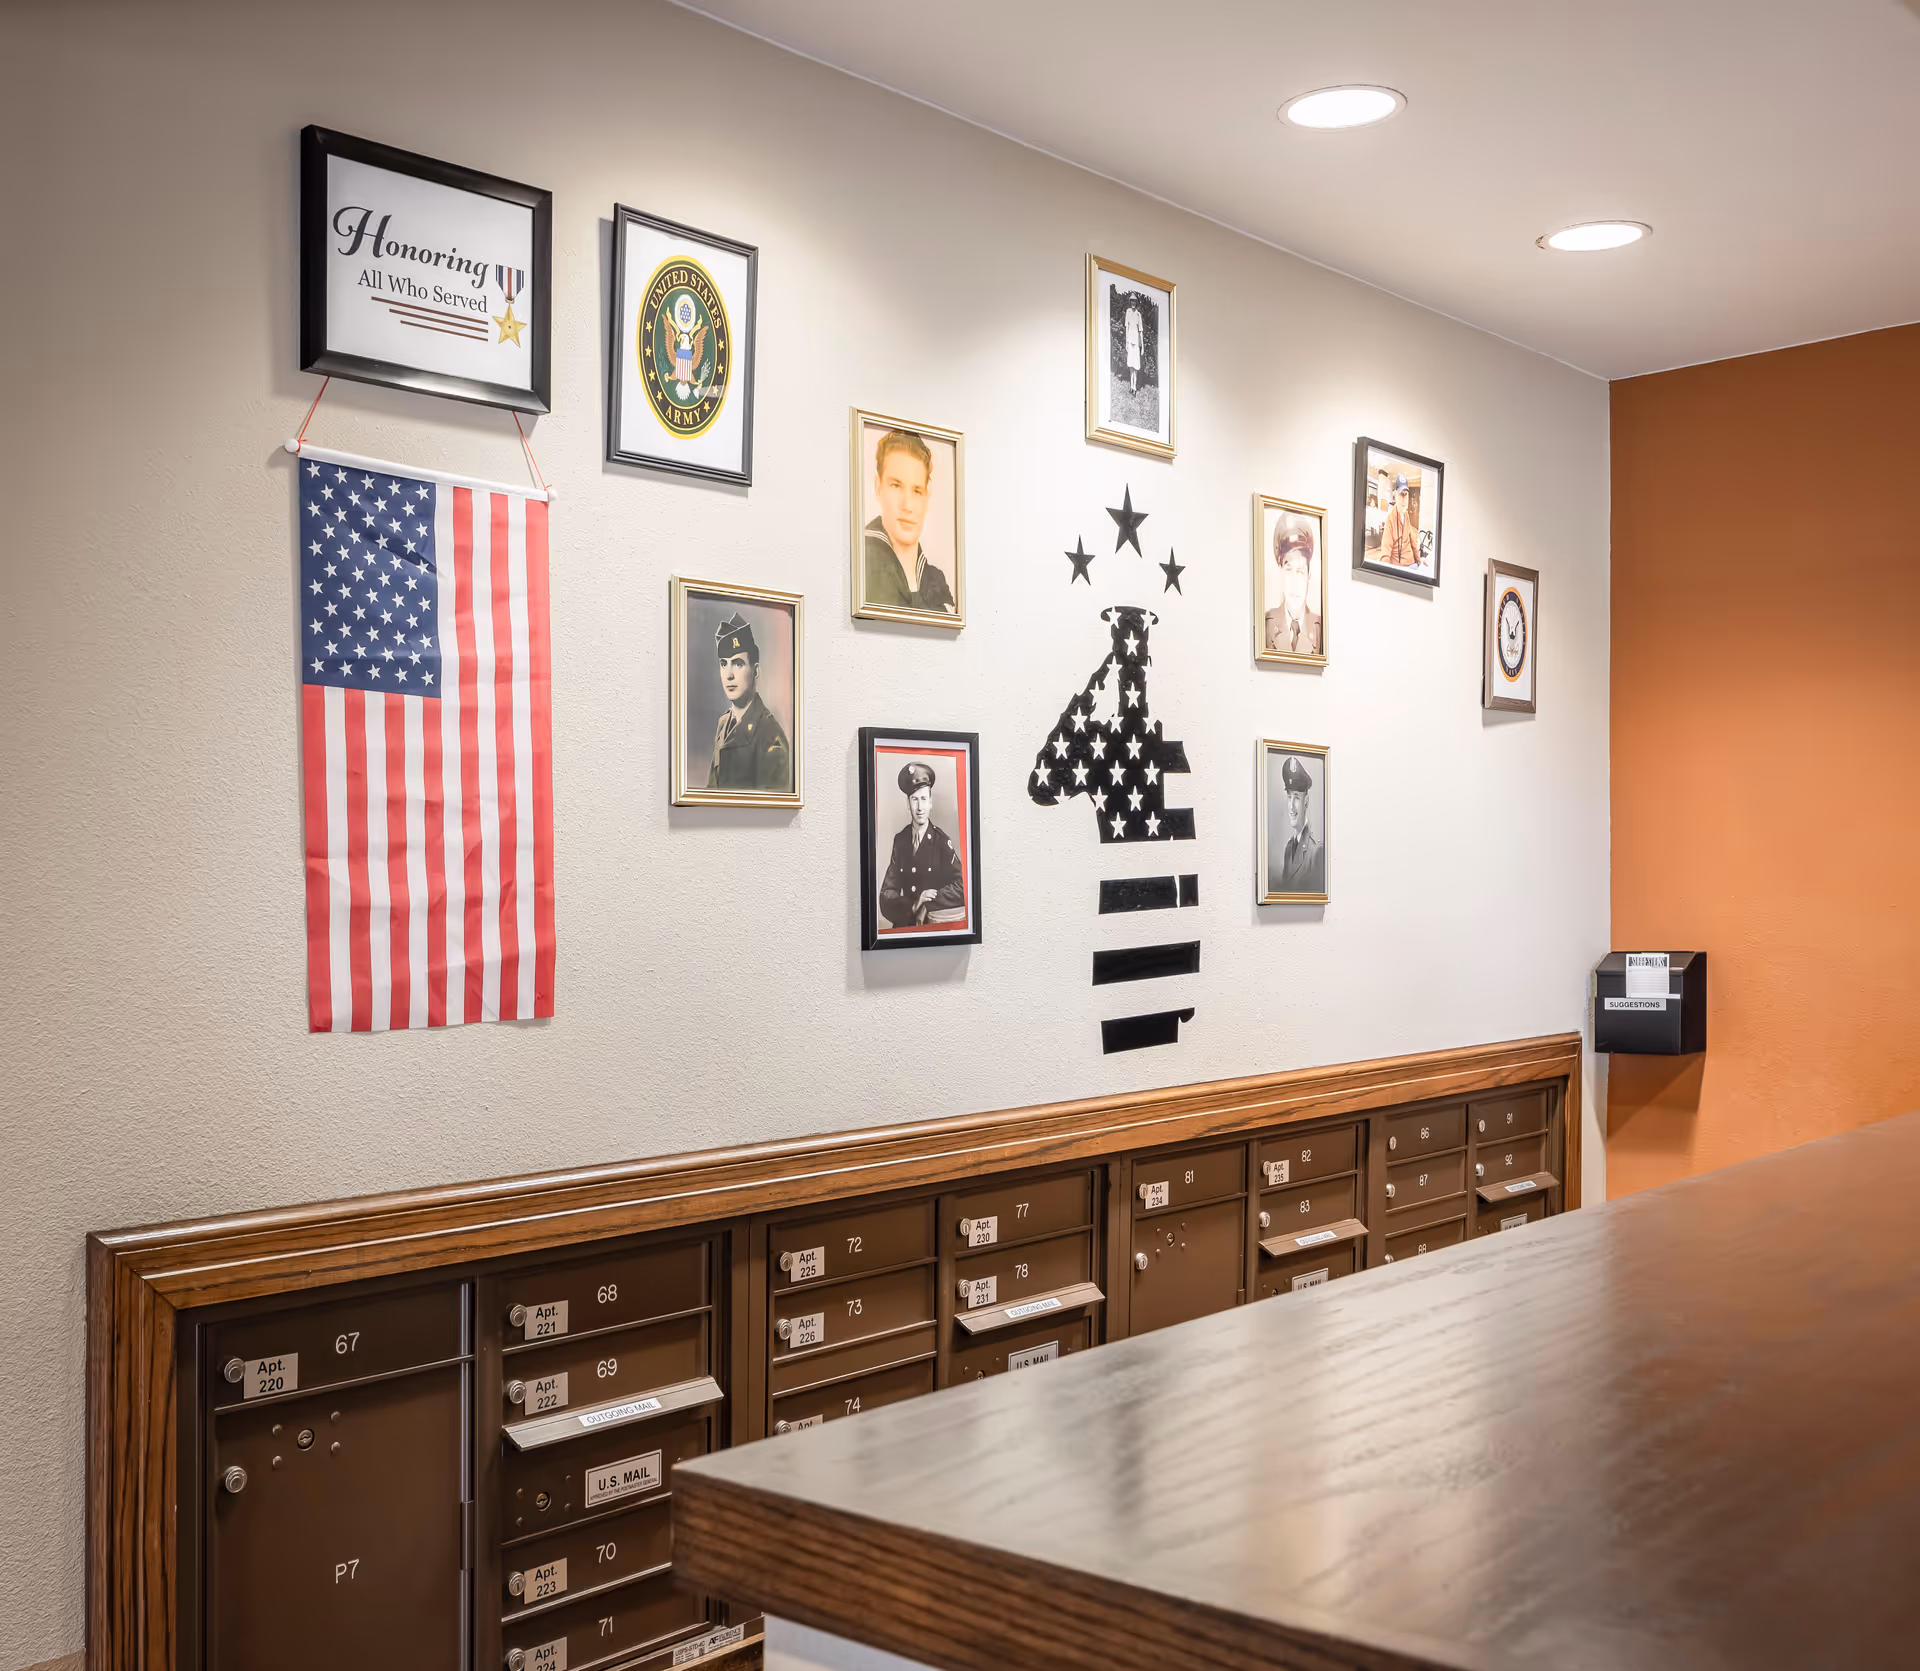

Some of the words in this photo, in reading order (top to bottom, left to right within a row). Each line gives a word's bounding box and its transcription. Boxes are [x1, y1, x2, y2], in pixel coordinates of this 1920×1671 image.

[333, 206, 490, 288] Honoring
[357, 268, 383, 292] All
[388, 274, 428, 300] Who
[432, 285, 488, 314] Served
[650, 270, 688, 311] UNITED
[690, 273, 722, 330] STATES
[665, 404, 702, 426] ARMY
[1609, 1001, 1661, 1009] SUGGESTIONS
[1506, 1113, 1513, 1124] 91
[1420, 1127, 1430, 1140] 86
[1301, 1149, 1312, 1163] 82
[1505, 1154, 1513, 1166] 92
[1273, 1163, 1285, 1173] Apt.
[1184, 1170, 1195, 1184] 81
[1274, 1173, 1284, 1184] 235
[1419, 1174, 1429, 1187] 87
[1151, 1184, 1164, 1195] Apt.
[1151, 1195, 1163, 1207] 234
[1299, 1200, 1310, 1213] 83
[1016, 1203, 1030, 1219] 77
[975, 1219, 991, 1232] Apt.
[847, 1237, 862, 1254] 72
[976, 1232, 990, 1245] 230
[799, 1251, 817, 1264] Apt.
[800, 1264, 816, 1278] 225
[1015, 1263, 1029, 1280] 78
[974, 1279, 991, 1292] Apt.
[597, 1284, 617, 1304] 68
[976, 1292, 990, 1305] 231
[535, 1305, 558, 1320] Apt.
[847, 1299, 862, 1317] 73
[536, 1321, 556, 1336] 221
[798, 1317, 817, 1330] Apt.
[335, 1332, 360, 1355] 67
[799, 1330, 816, 1344] 226
[257, 1358, 286, 1376] Apt.
[597, 1358, 617, 1379] 69
[259, 1377, 284, 1394] 220
[535, 1379, 558, 1394] Apt.
[537, 1394, 557, 1410] 222
[844, 1396, 861, 1415] 74
[586, 1406, 634, 1424] OUTGOING
[633, 1401, 657, 1416] MAIL
[598, 1476, 620, 1491] U.S.
[623, 1466, 651, 1484] MAIL
[596, 1542, 616, 1563] 70
[335, 1558, 360, 1584] P7
[534, 1565, 558, 1583] Apt.
[536, 1581, 556, 1598] 223
[598, 1616, 613, 1637] 71
[534, 1645, 557, 1662] Apt.
